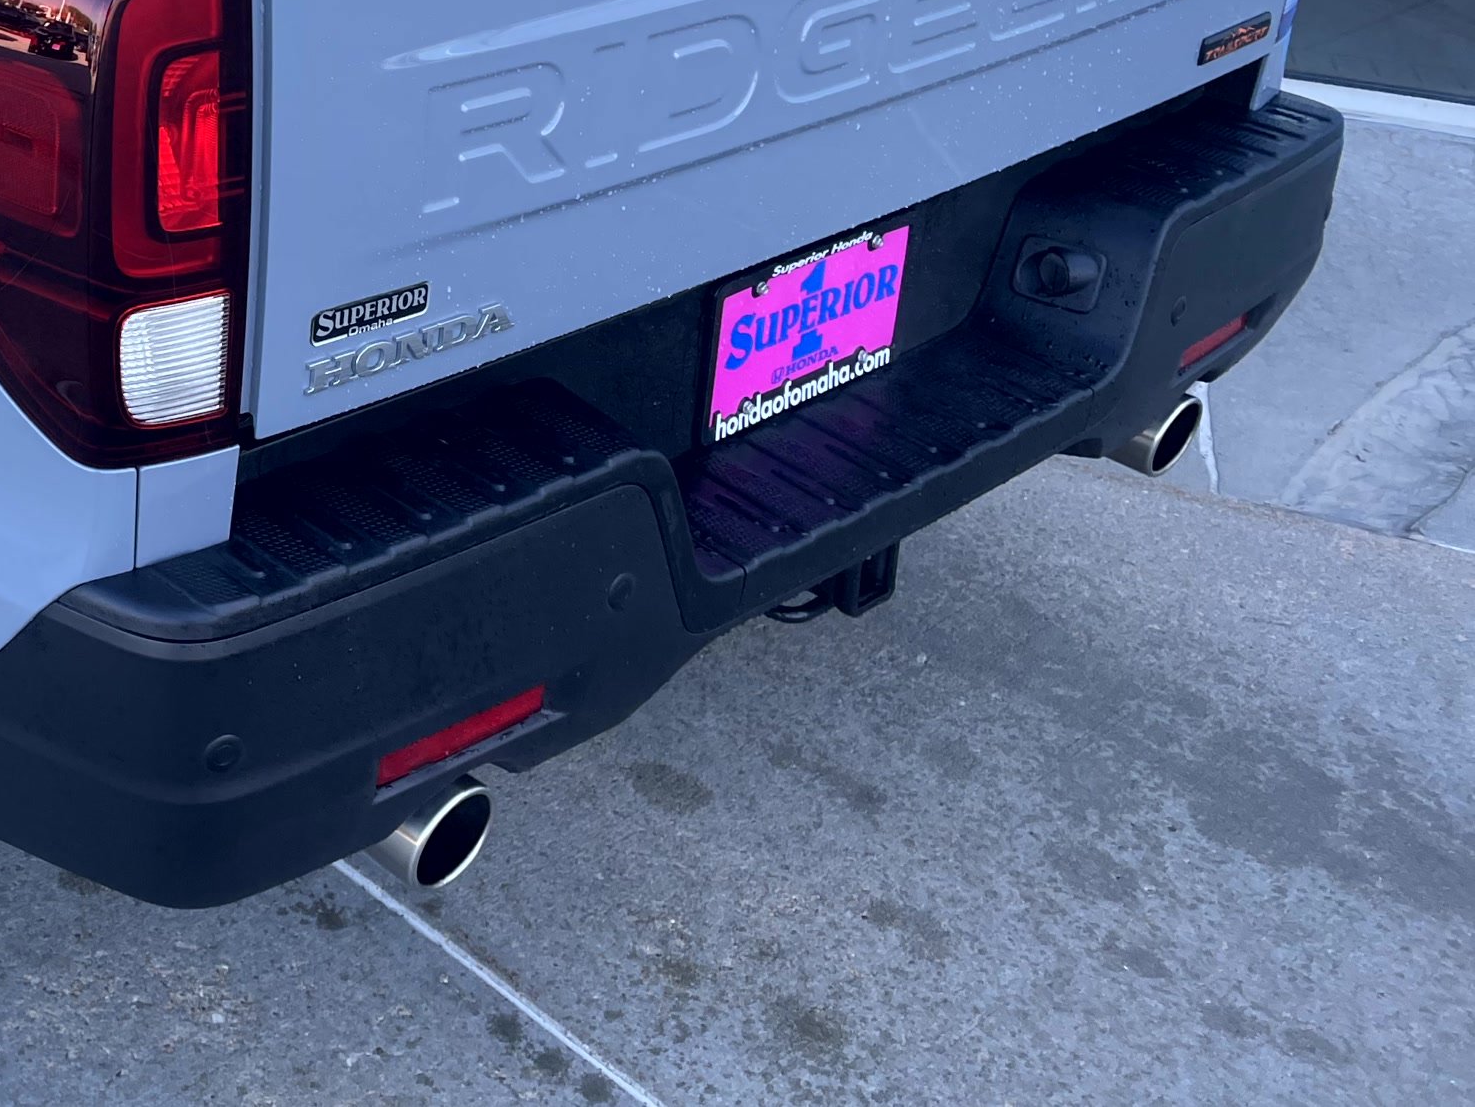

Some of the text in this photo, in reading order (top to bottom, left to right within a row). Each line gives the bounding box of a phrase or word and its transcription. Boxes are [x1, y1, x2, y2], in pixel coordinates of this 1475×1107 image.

[772, 231, 874, 277] Superior Honda
[316, 286, 426, 337] SUPERIOR
[347, 317, 393, 336] Omaha
[724, 264, 899, 371] SUPERIOR
[303, 301, 515, 396] HONDA
[785, 346, 840, 376] HONDA
[714, 347, 891, 442] hondaofomaha.com
